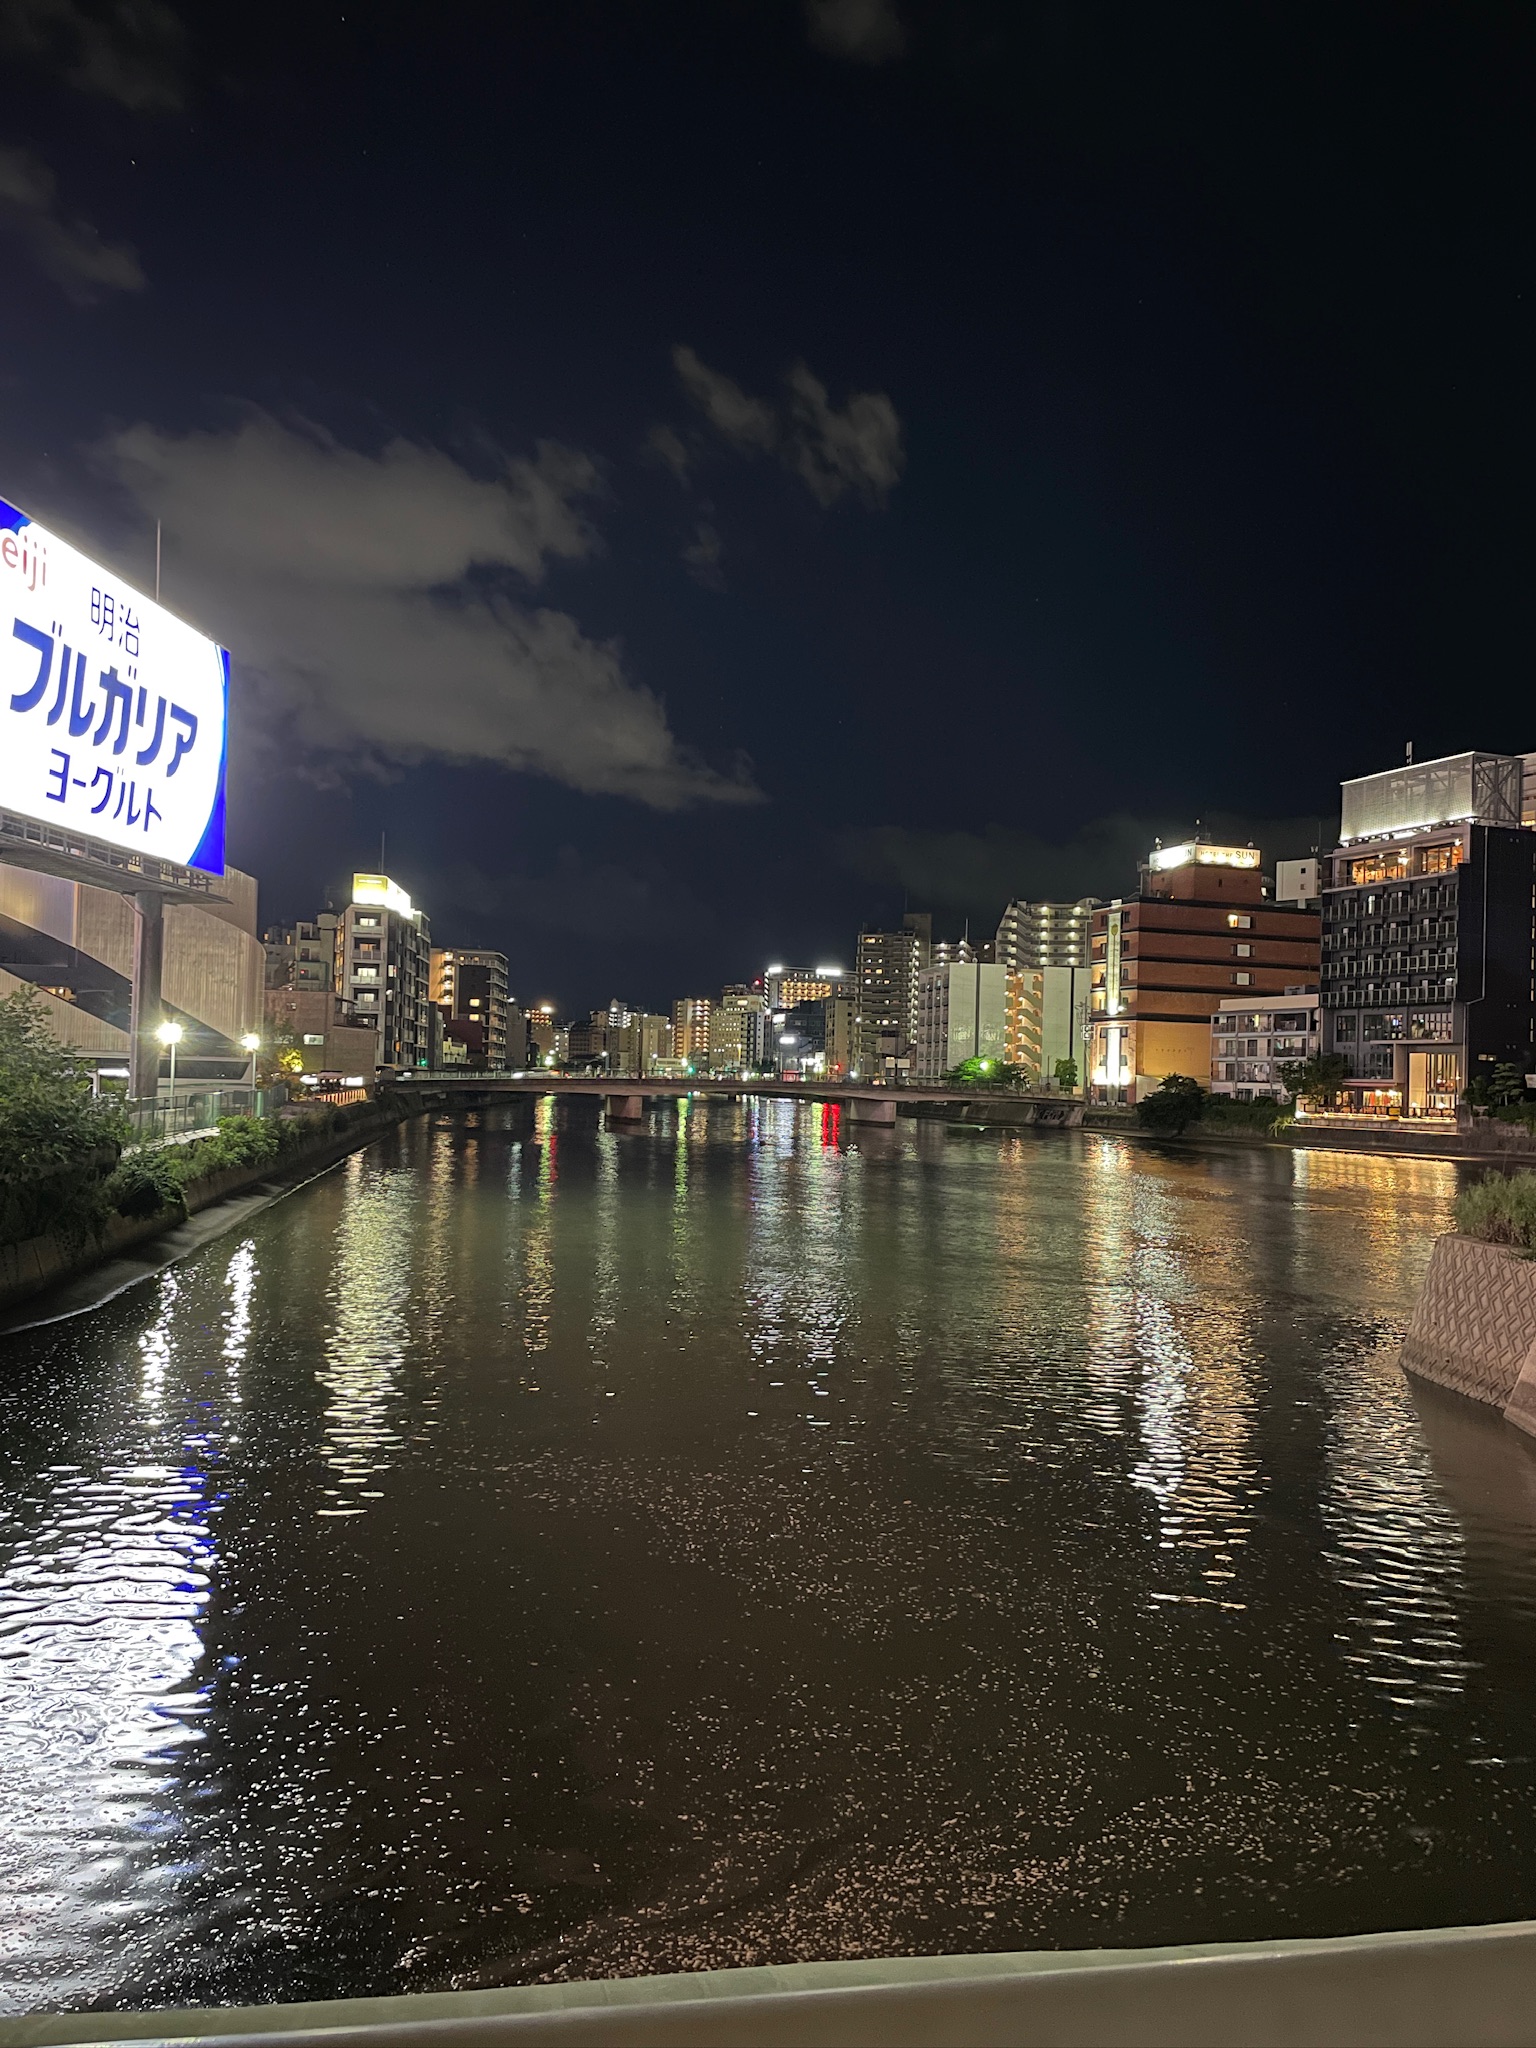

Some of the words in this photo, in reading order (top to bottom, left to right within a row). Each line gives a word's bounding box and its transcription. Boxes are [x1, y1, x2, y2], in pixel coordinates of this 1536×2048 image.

[90, 586, 140, 658] 明治
[10, 618, 198, 778] ブルガリア
[46, 748, 162, 833] ヨーグルト
[1235, 850, 1255, 859] SUN
